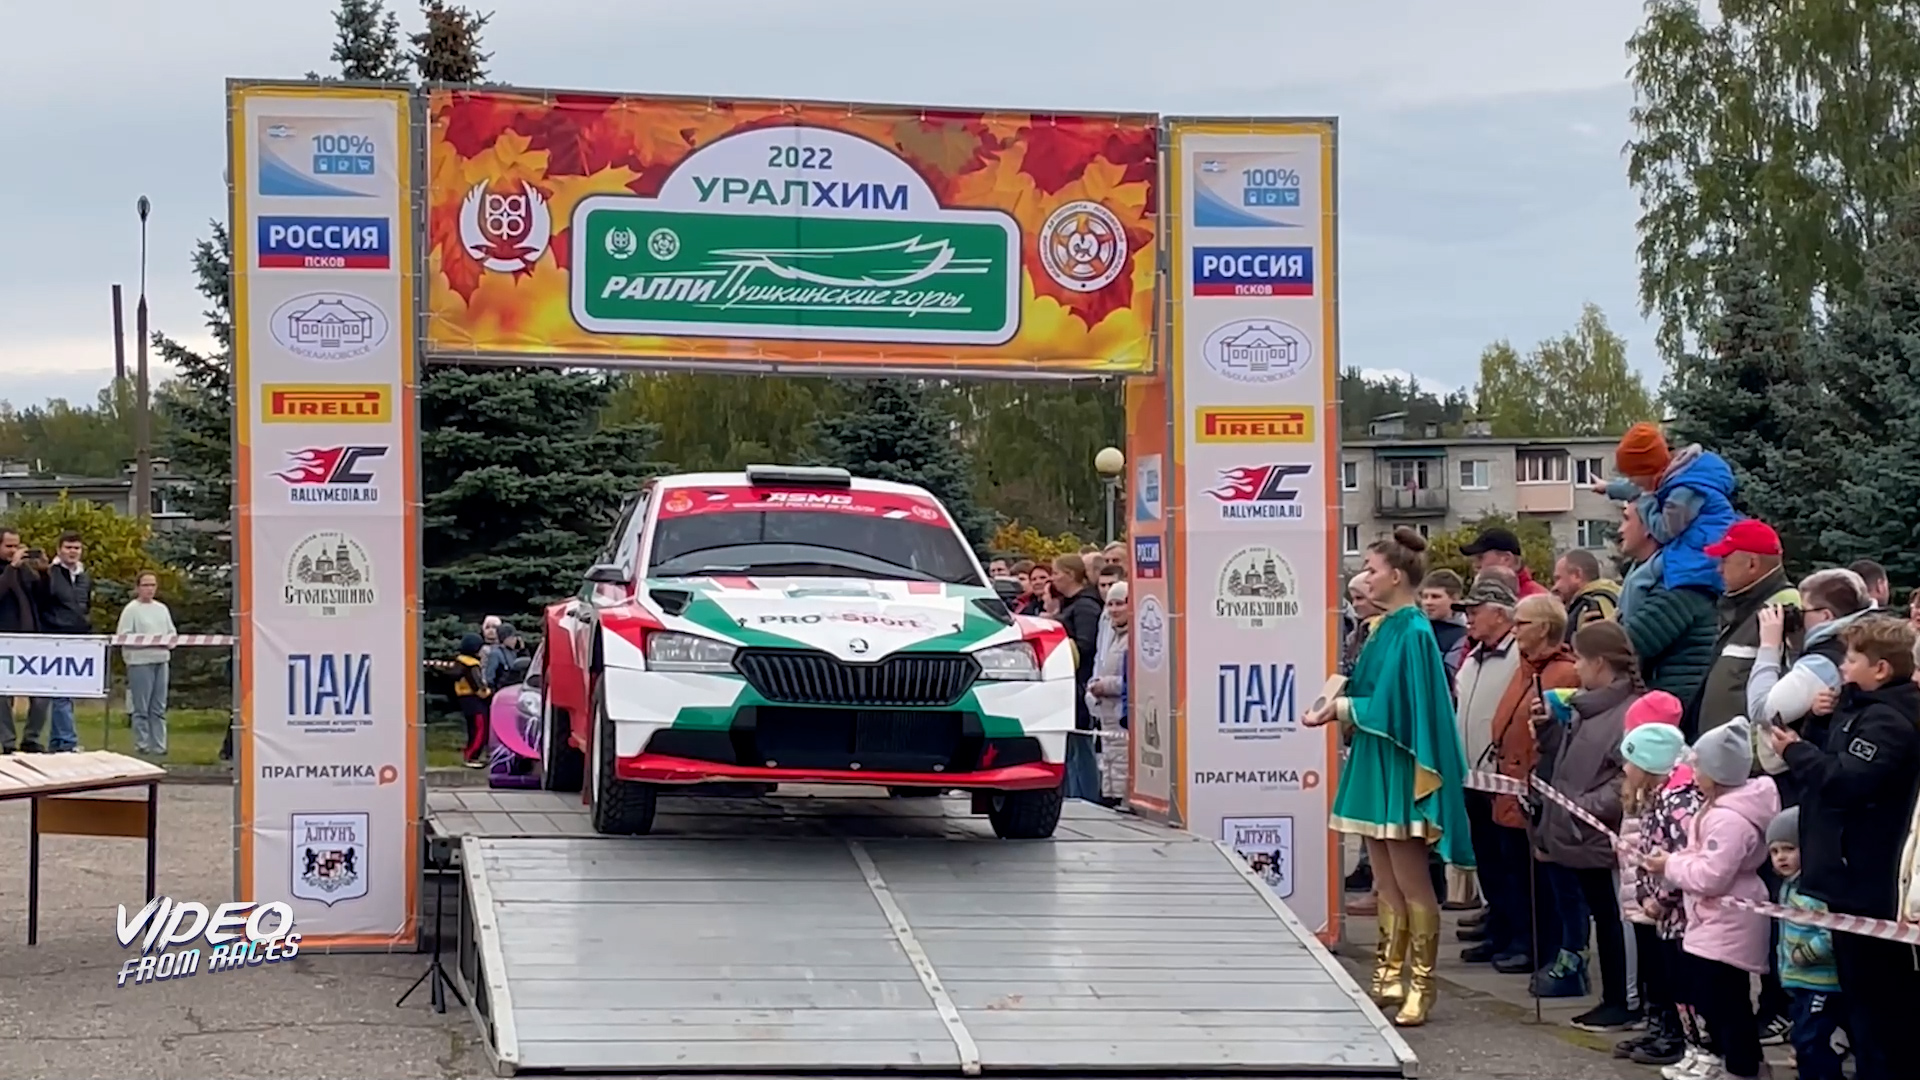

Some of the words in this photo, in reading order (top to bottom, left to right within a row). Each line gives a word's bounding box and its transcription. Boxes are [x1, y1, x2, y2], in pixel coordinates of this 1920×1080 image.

[312, 134, 375, 154] 100%
[768, 145, 833, 170] 2022
[1242, 168, 1300, 187] 100%
[691, 175, 909, 211] УРАЛХИМ
[269, 225, 379, 250] РОССИЯ
[304, 256, 346, 268] ПСКОВ
[1203, 254, 1304, 278] РОССИЯ
[600, 275, 716, 302] РАЛЛИ
[710, 262, 890, 310] Пушкинские
[889, 288, 964, 317] горы
[1235, 284, 1273, 296] ПСКОВ
[271, 391, 381, 415] PIRELLI
[1204, 412, 1304, 436] PIRELLI
[291, 487, 378, 502] RALLYMEDIA.RU
[1222, 505, 1303, 518] RALLYMEDIA.RU
[288, 653, 371, 715] ПАИ
[1219, 663, 1295, 724] ПАИ
[261, 764, 376, 779] ПРАГМАТИКА
[1194, 770, 1300, 784] ПРАГМАТИКА
[304, 825, 357, 842] АЛТУНЪ
[1234, 828, 1282, 846] АЛТУНЪ
